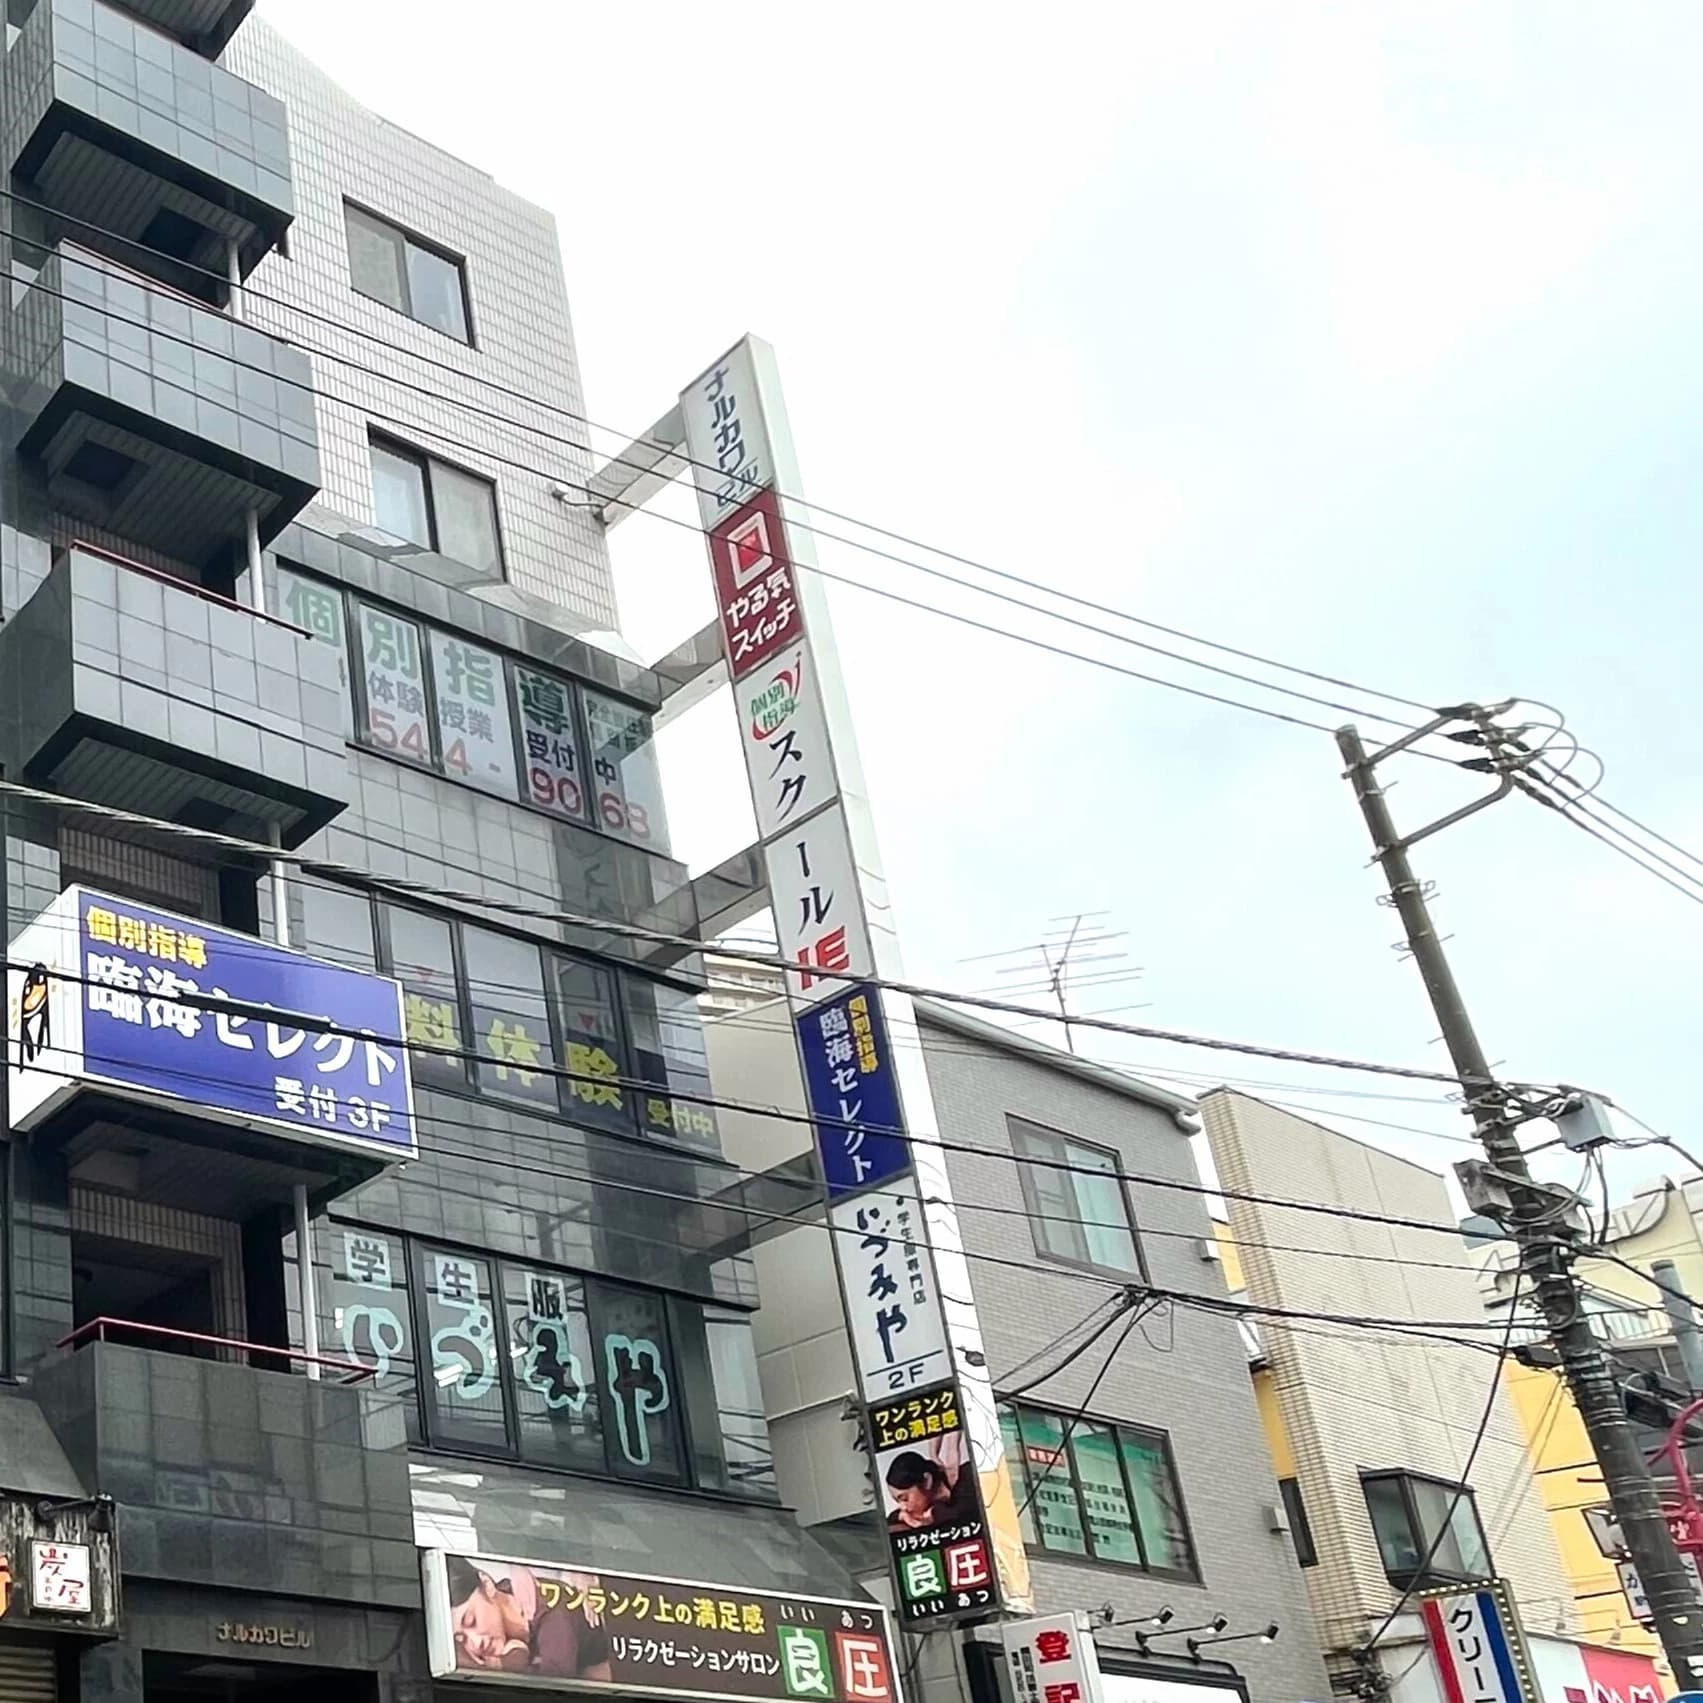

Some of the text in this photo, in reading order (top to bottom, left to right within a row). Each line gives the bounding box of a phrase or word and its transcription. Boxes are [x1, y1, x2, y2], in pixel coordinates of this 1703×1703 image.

[727, 566, 791, 628] やる気
[731, 598, 796, 661] スイッチ
[768, 730, 834, 935] スクール
[85, 904, 208, 969] 個別指導
[797, 925, 850, 991] IE
[86, 952, 398, 1087] 臨海セレクト
[273, 1076, 392, 1133] 受付 3F
[818, 1006, 873, 1183] 臨海セレクト
[888, 1362, 926, 1390] 2F
[875, 1390, 955, 1428] ワンランク
[879, 1408, 960, 1447] 上の満足感
[896, 1520, 983, 1552] リラクゼーション
[538, 1581, 766, 1635] ワンランク上の満足感
[611, 1634, 782, 1675] リラクゼーションサロン
[1449, 1607, 1496, 1703] クリー
